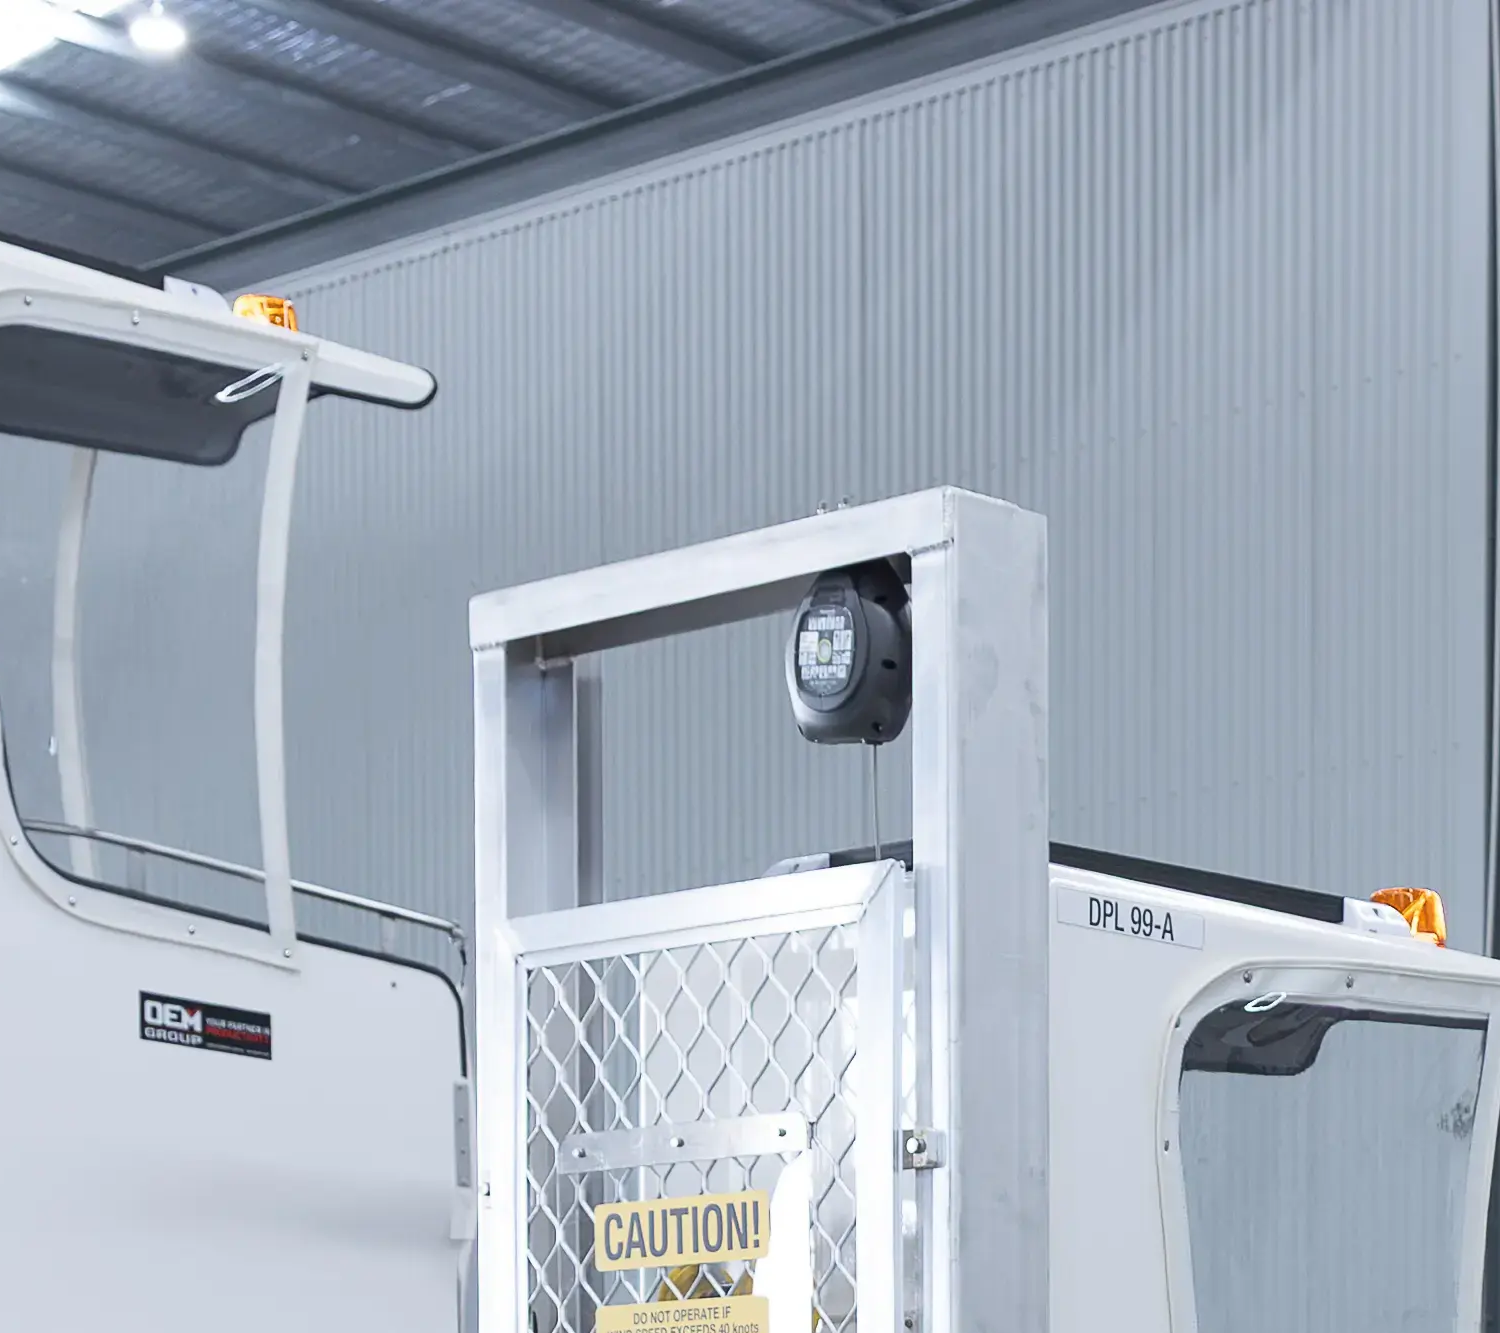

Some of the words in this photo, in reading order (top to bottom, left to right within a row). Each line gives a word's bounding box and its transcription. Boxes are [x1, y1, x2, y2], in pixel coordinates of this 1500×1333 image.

[1089, 897, 1125, 932] DPL
[1131, 906, 1174, 941] 99-A
[144, 1000, 203, 1033] OEM
[604, 1201, 760, 1261] CAUTION!
[633, 1312, 648, 1325] DO
[651, 1310, 670, 1324] NOT
[673, 1307, 719, 1322] OPERATE
[722, 1306, 731, 1318] IF
